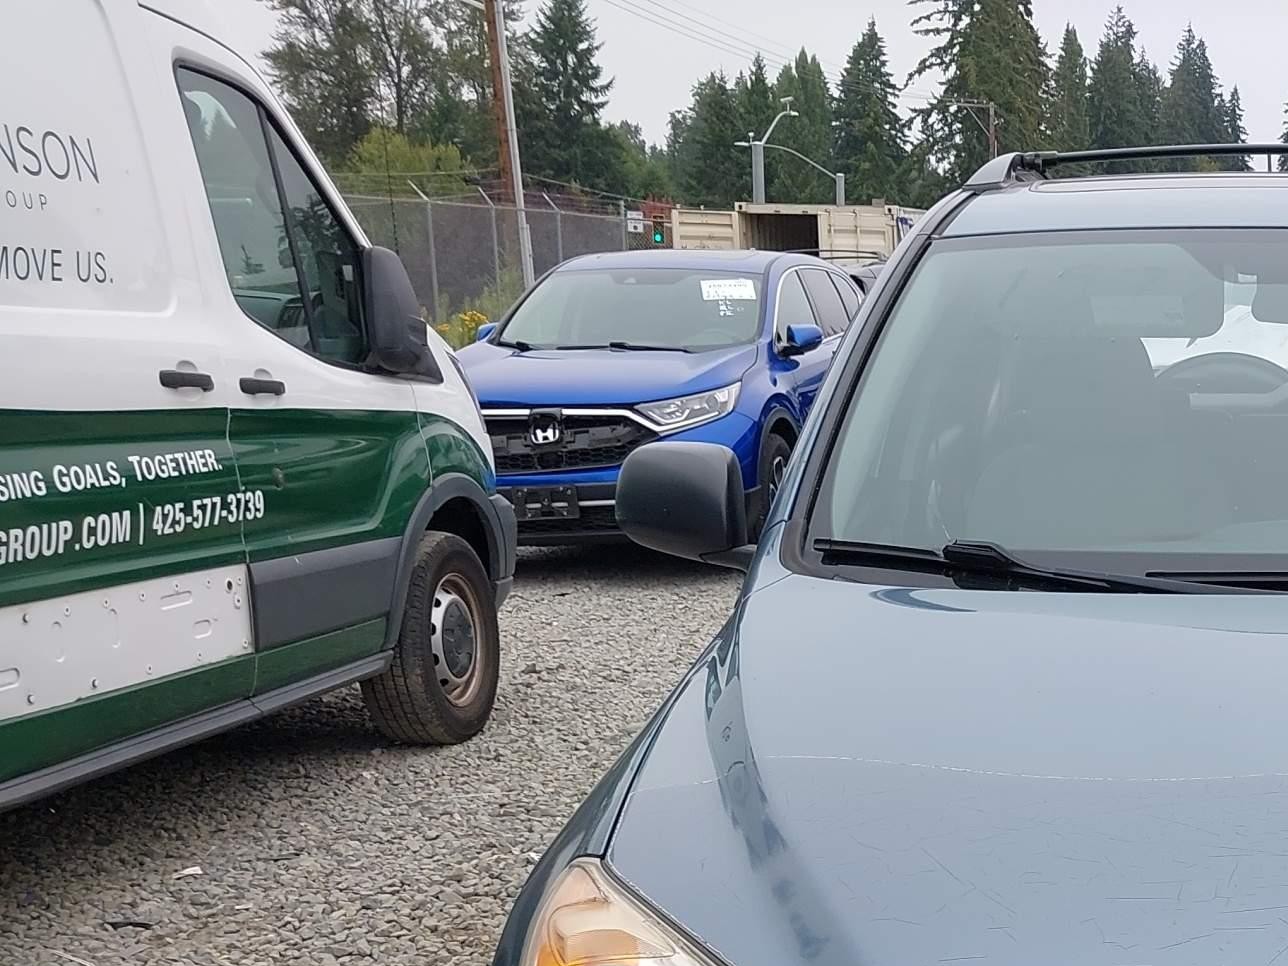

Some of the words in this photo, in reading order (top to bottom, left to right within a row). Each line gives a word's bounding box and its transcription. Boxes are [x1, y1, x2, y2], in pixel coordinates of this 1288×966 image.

[6, 190, 47, 210] OUP
[76, 250, 113, 283] US.
[0, 470, 47, 502] SING
[53, 463, 126, 493] GOALS,
[128, 449, 223, 482] TOGETHER.
[152, 490, 265, 535] 425-577-3739
